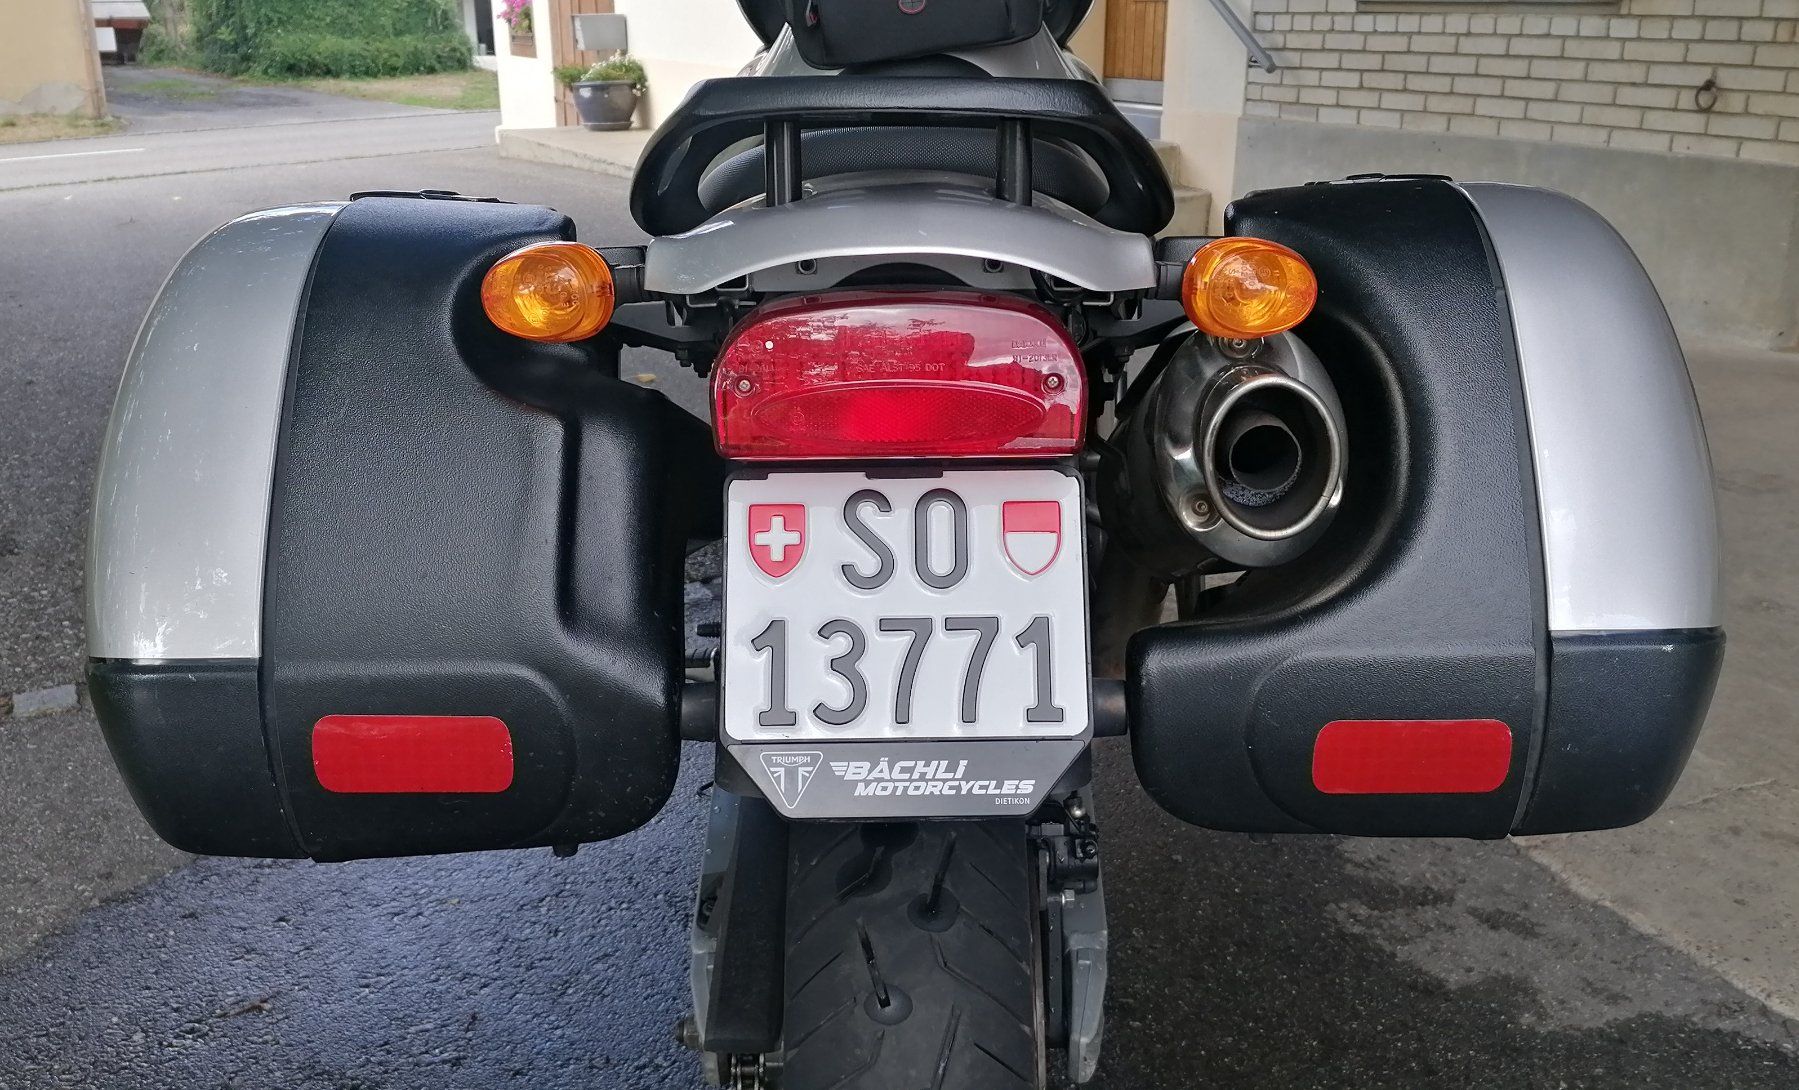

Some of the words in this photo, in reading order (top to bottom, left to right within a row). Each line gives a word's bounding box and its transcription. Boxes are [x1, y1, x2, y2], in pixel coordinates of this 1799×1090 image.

[925, 362, 946, 372] DOT
[841, 487, 969, 590] SO
[750, 616, 1064, 727] 13771
[771, 755, 811, 764] TRIUMPH
[853, 780, 1036, 796] MOTORCYCLES
[995, 797, 1031, 805] DIETIKON
